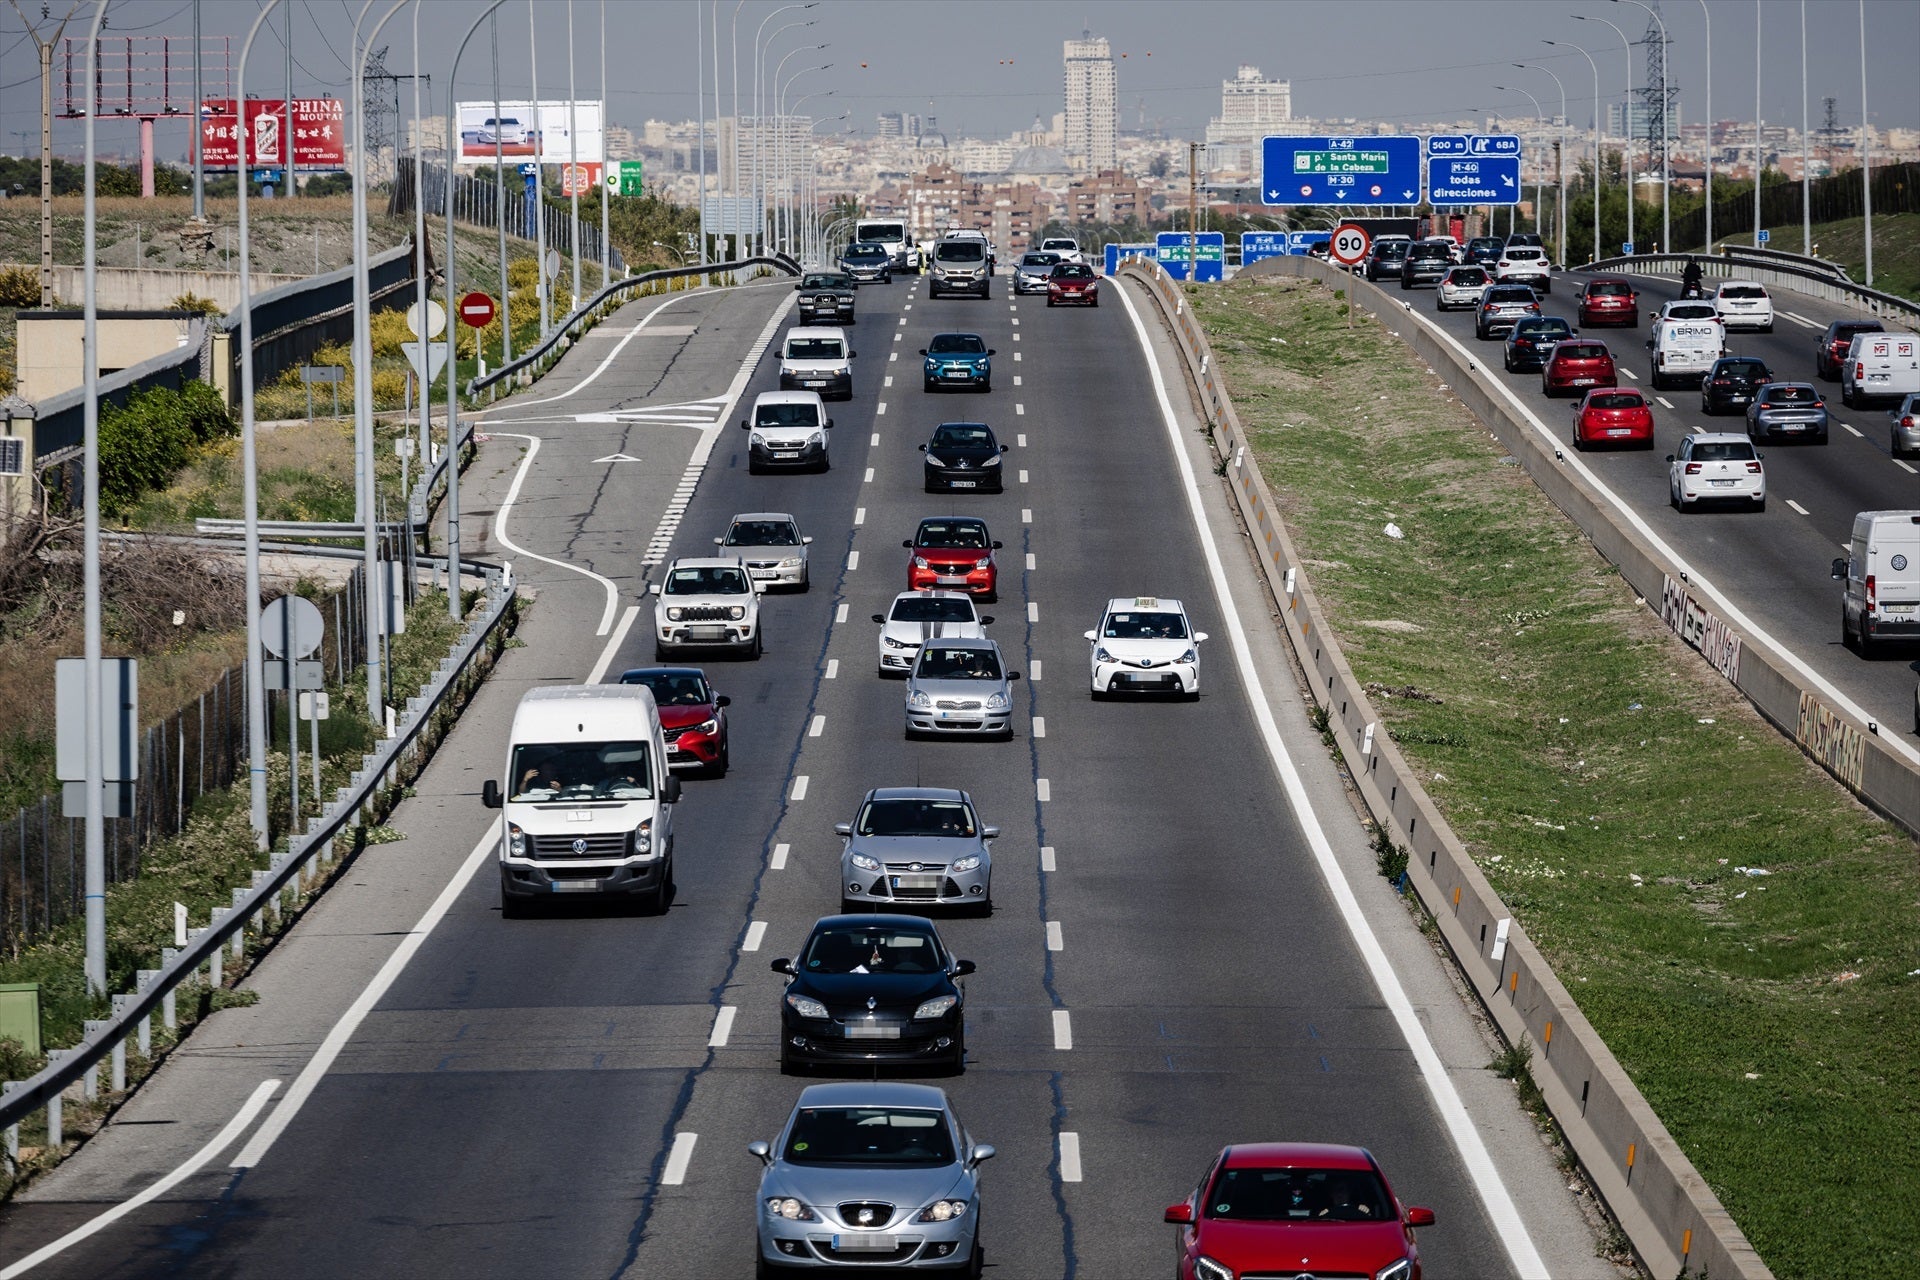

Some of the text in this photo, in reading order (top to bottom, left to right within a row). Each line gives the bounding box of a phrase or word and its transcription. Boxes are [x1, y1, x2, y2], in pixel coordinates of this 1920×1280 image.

[291, 100, 342, 113] CHINA
[299, 113, 343, 121] MOUTAI
[1330, 140, 1352, 148] A-42
[1432, 141, 1451, 149] 500
[1330, 153, 1357, 161] Santa
[1342, 163, 1375, 171] Cabeza
[1453, 163, 1477, 171] M-40
[1329, 176, 1353, 184] M-30
[1449, 175, 1480, 184] todas
[1433, 188, 1497, 198] direcciones
[1339, 236, 1362, 251] 90
[1677, 327, 1712, 335] BRIMO
